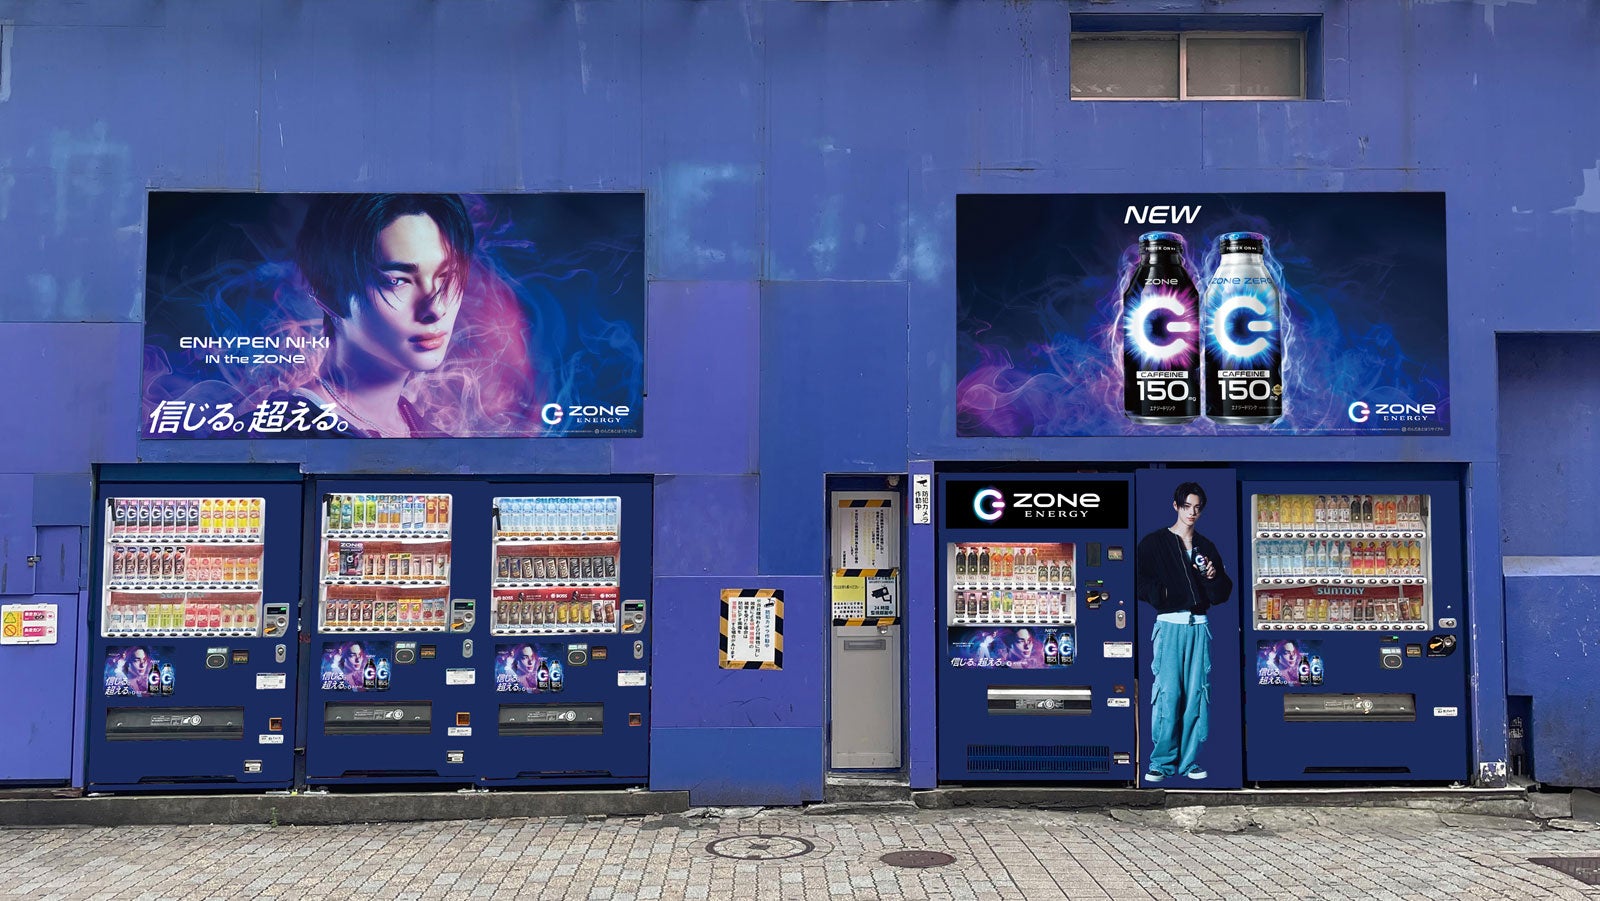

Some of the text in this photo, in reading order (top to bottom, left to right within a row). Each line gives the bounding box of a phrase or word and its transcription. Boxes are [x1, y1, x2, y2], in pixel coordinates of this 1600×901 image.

[1124, 205, 1202, 224] NEW
[179, 336, 330, 349] ENHYPEN NI-KI
[205, 355, 220, 364] IN
[224, 354, 249, 364] the
[1136, 380, 1189, 401] 150
[1218, 379, 1271, 401] 150
[914, 490, 922, 510] 作動中
[921, 490, 929, 523] 防犯カメラ
[1024, 510, 1089, 518] ENERGY
